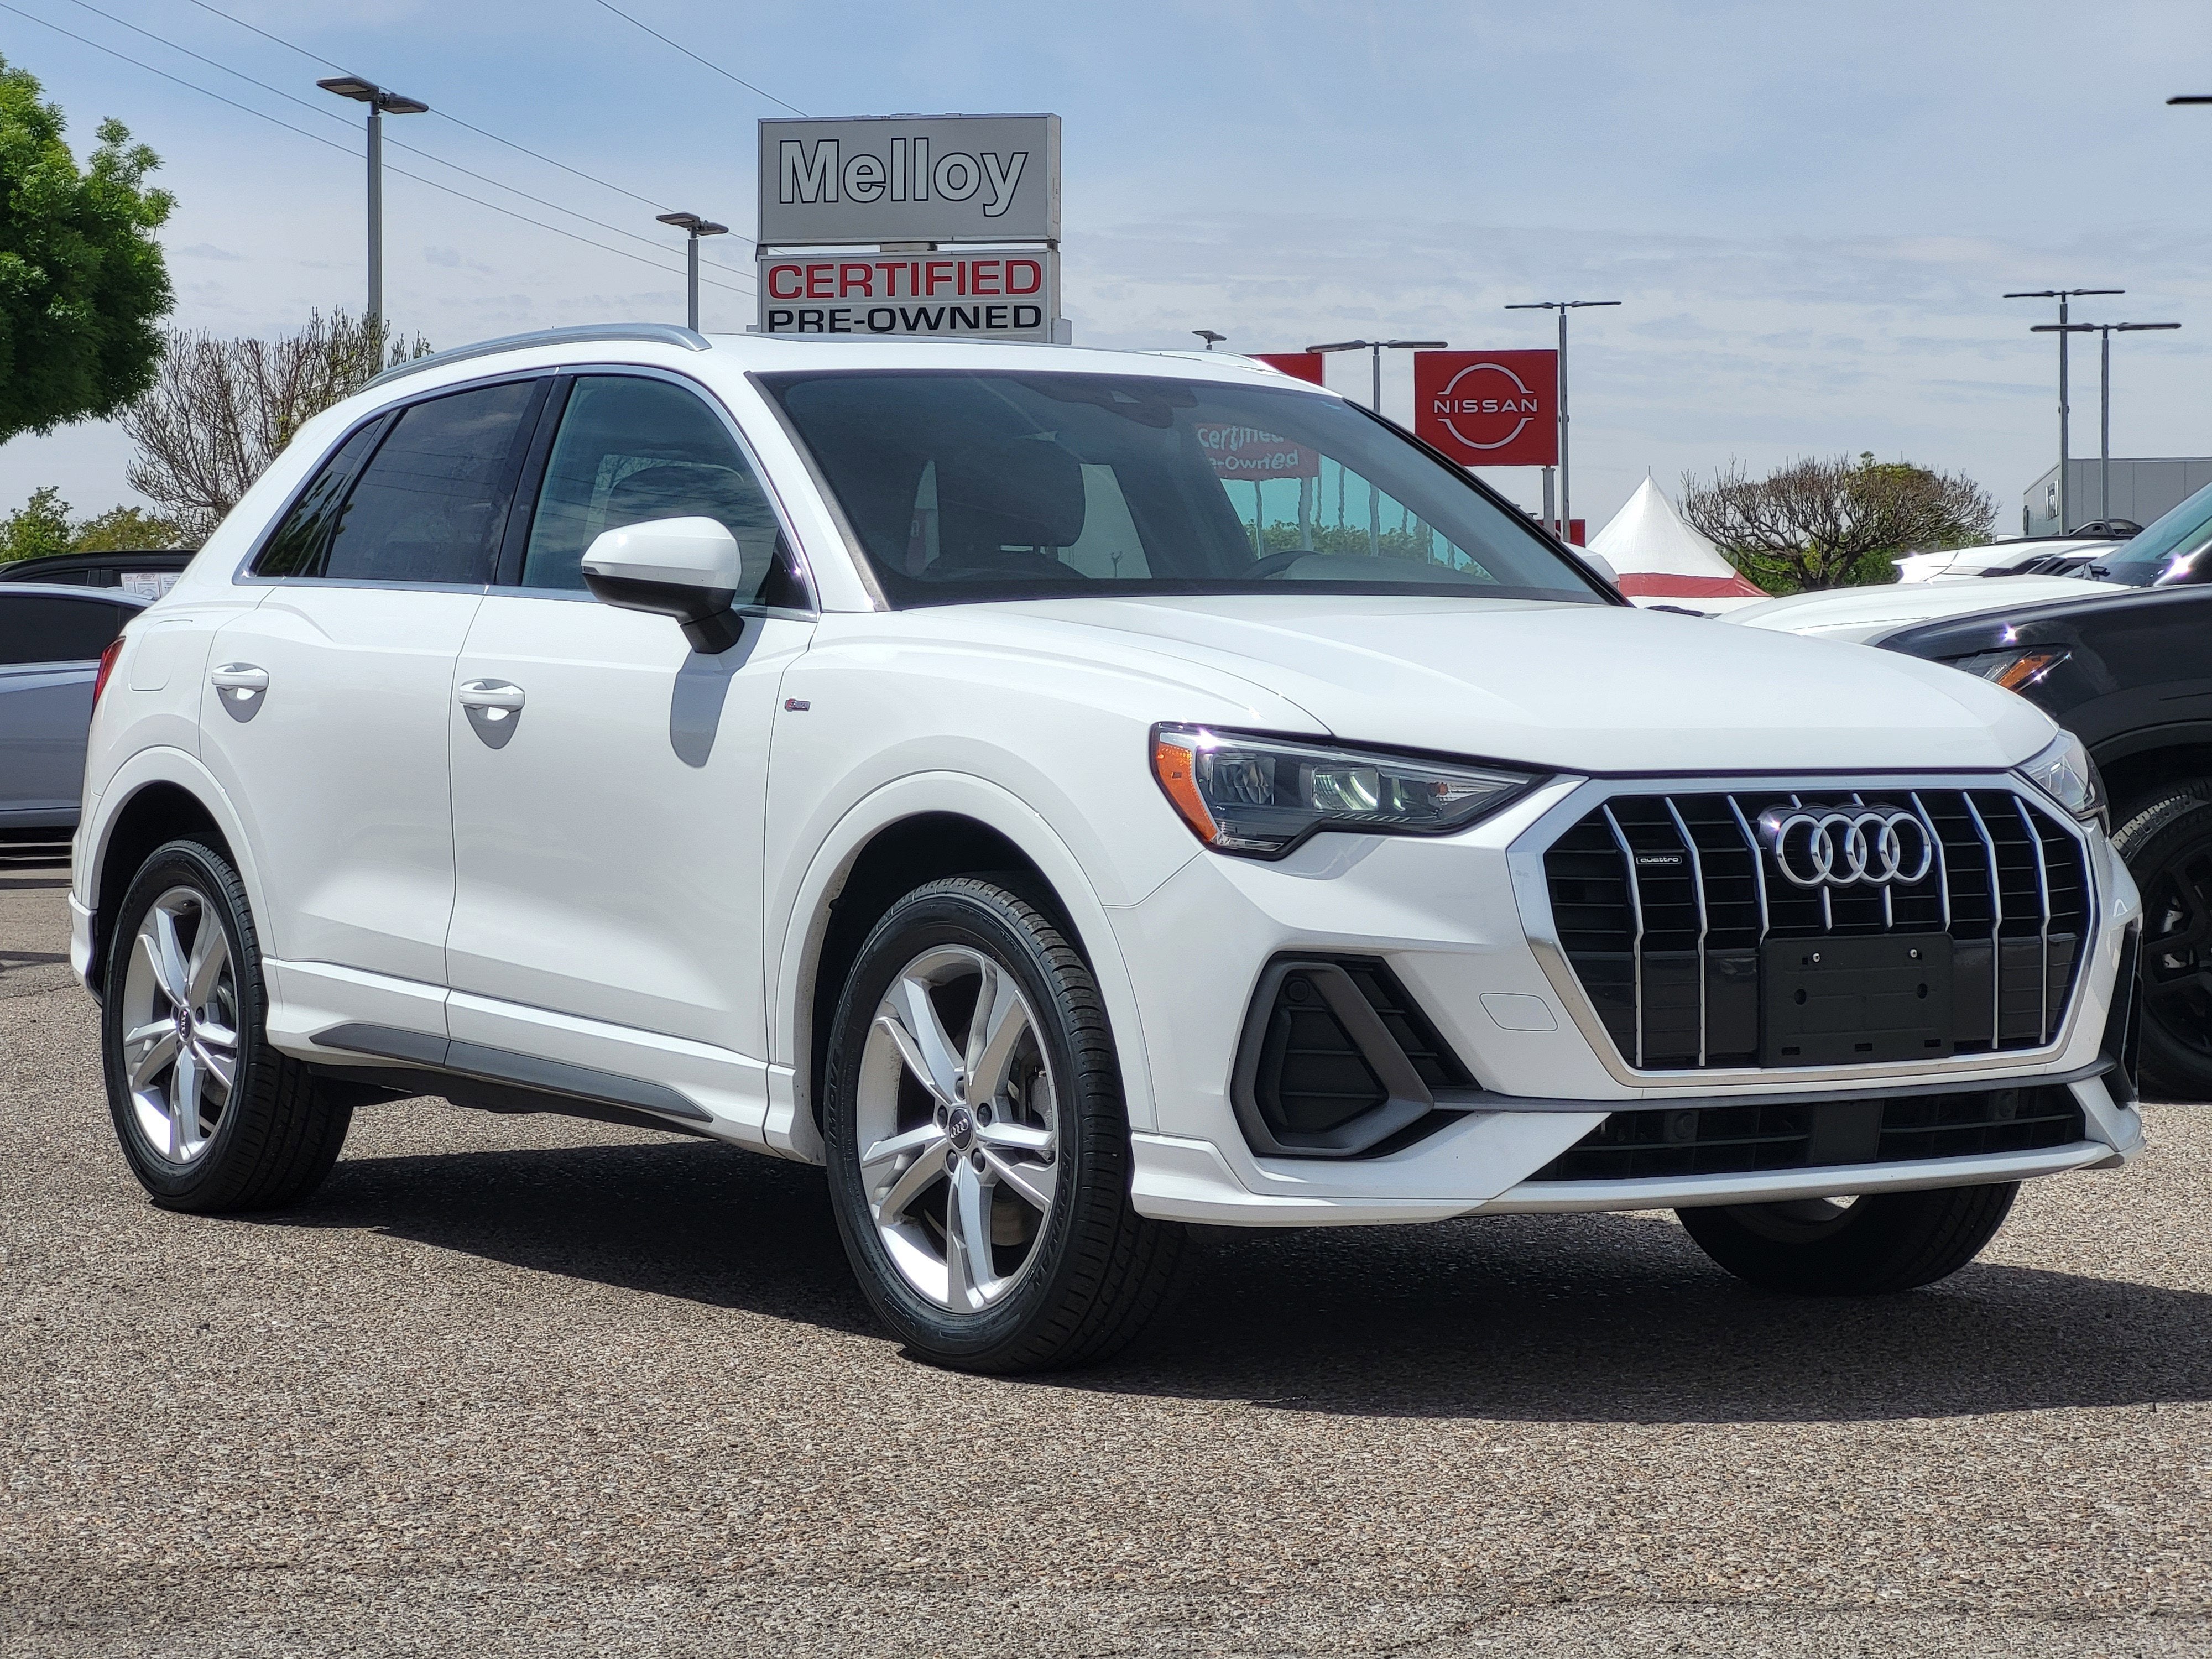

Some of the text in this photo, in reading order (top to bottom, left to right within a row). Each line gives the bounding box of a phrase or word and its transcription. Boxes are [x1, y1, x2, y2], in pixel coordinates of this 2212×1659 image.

[779, 137, 1029, 217] Melloy
[768, 259, 1042, 299] CERTIFIED
[769, 305, 1042, 332] PRE-OWNED
[1434, 399, 1538, 414] NISSAN
